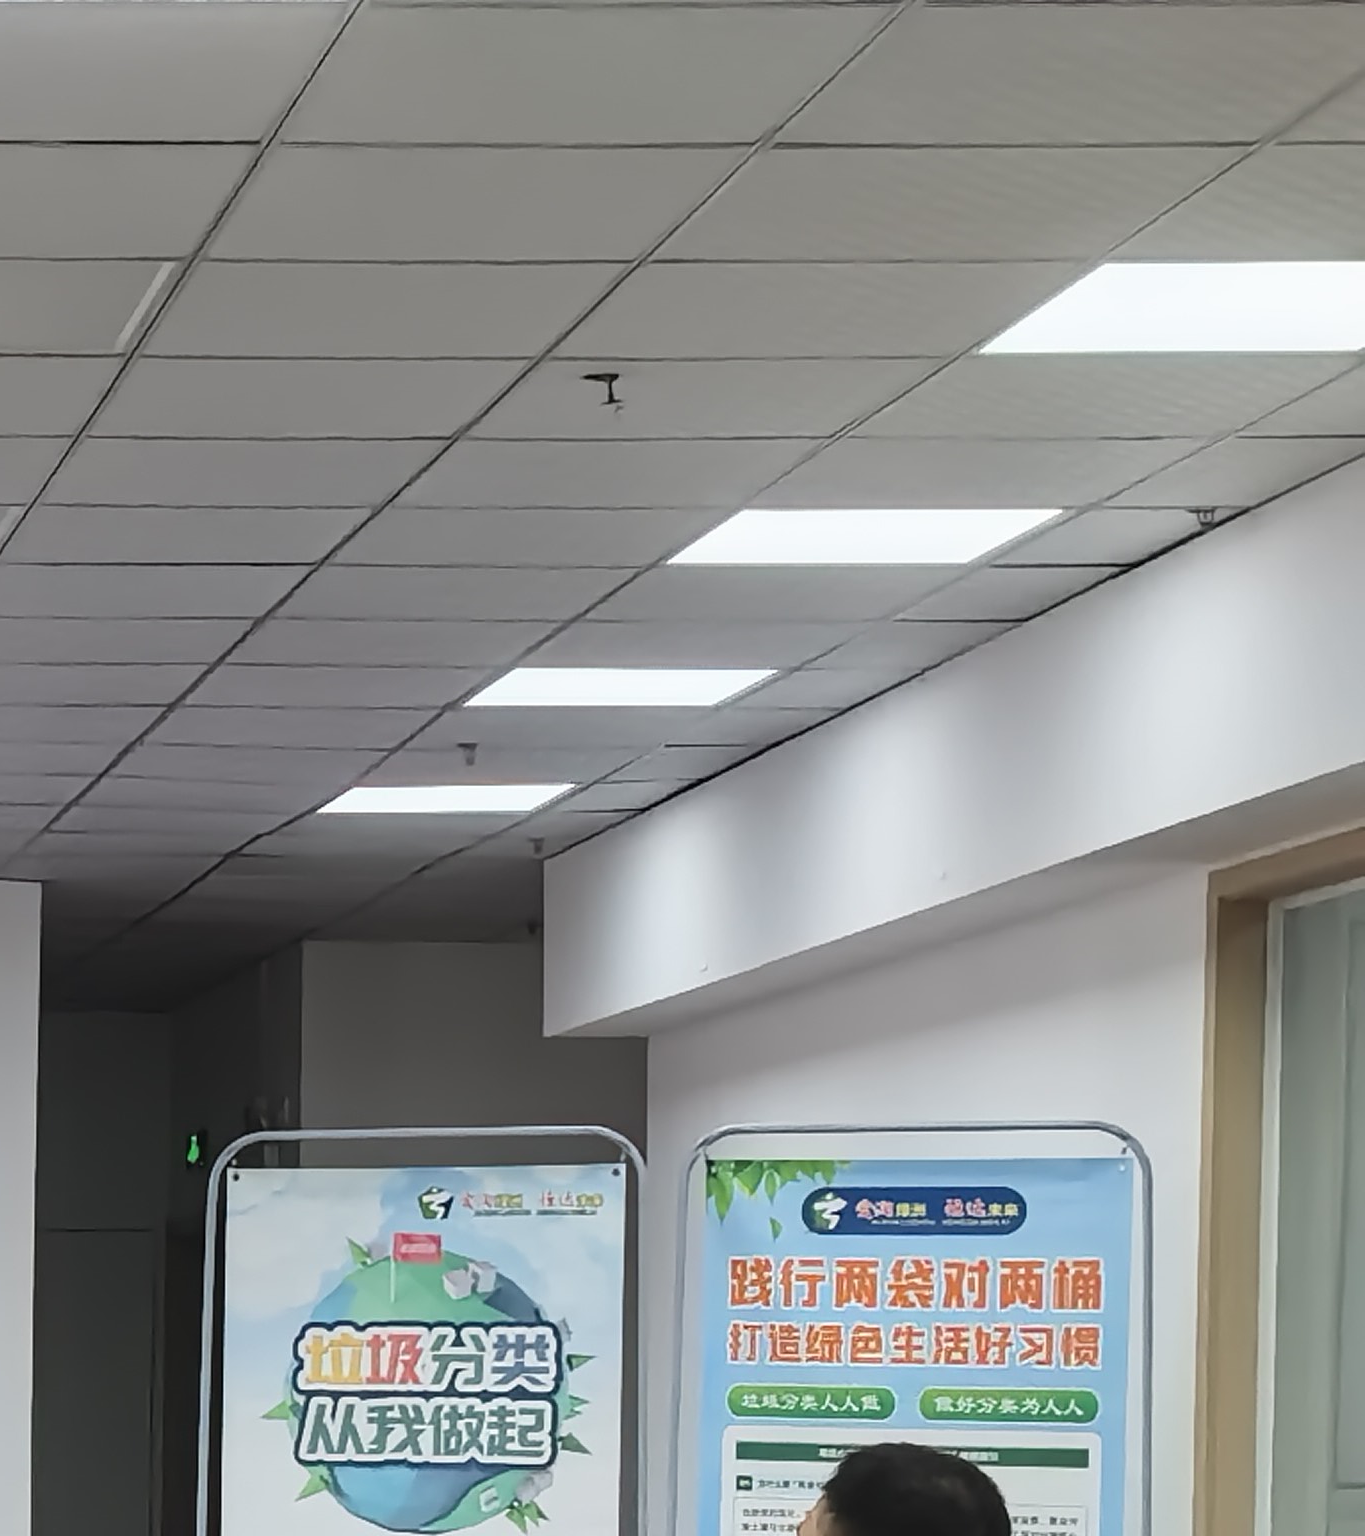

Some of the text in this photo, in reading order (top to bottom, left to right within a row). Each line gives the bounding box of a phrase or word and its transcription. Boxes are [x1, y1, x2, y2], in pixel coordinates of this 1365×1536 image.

[727, 1256, 1104, 1311] 践行两袋对两桶
[303, 1331, 552, 1387] 垃圾分类
[726, 1322, 1104, 1369] 打造绿色生活好习惯
[305, 1402, 547, 1457] 从我做起
